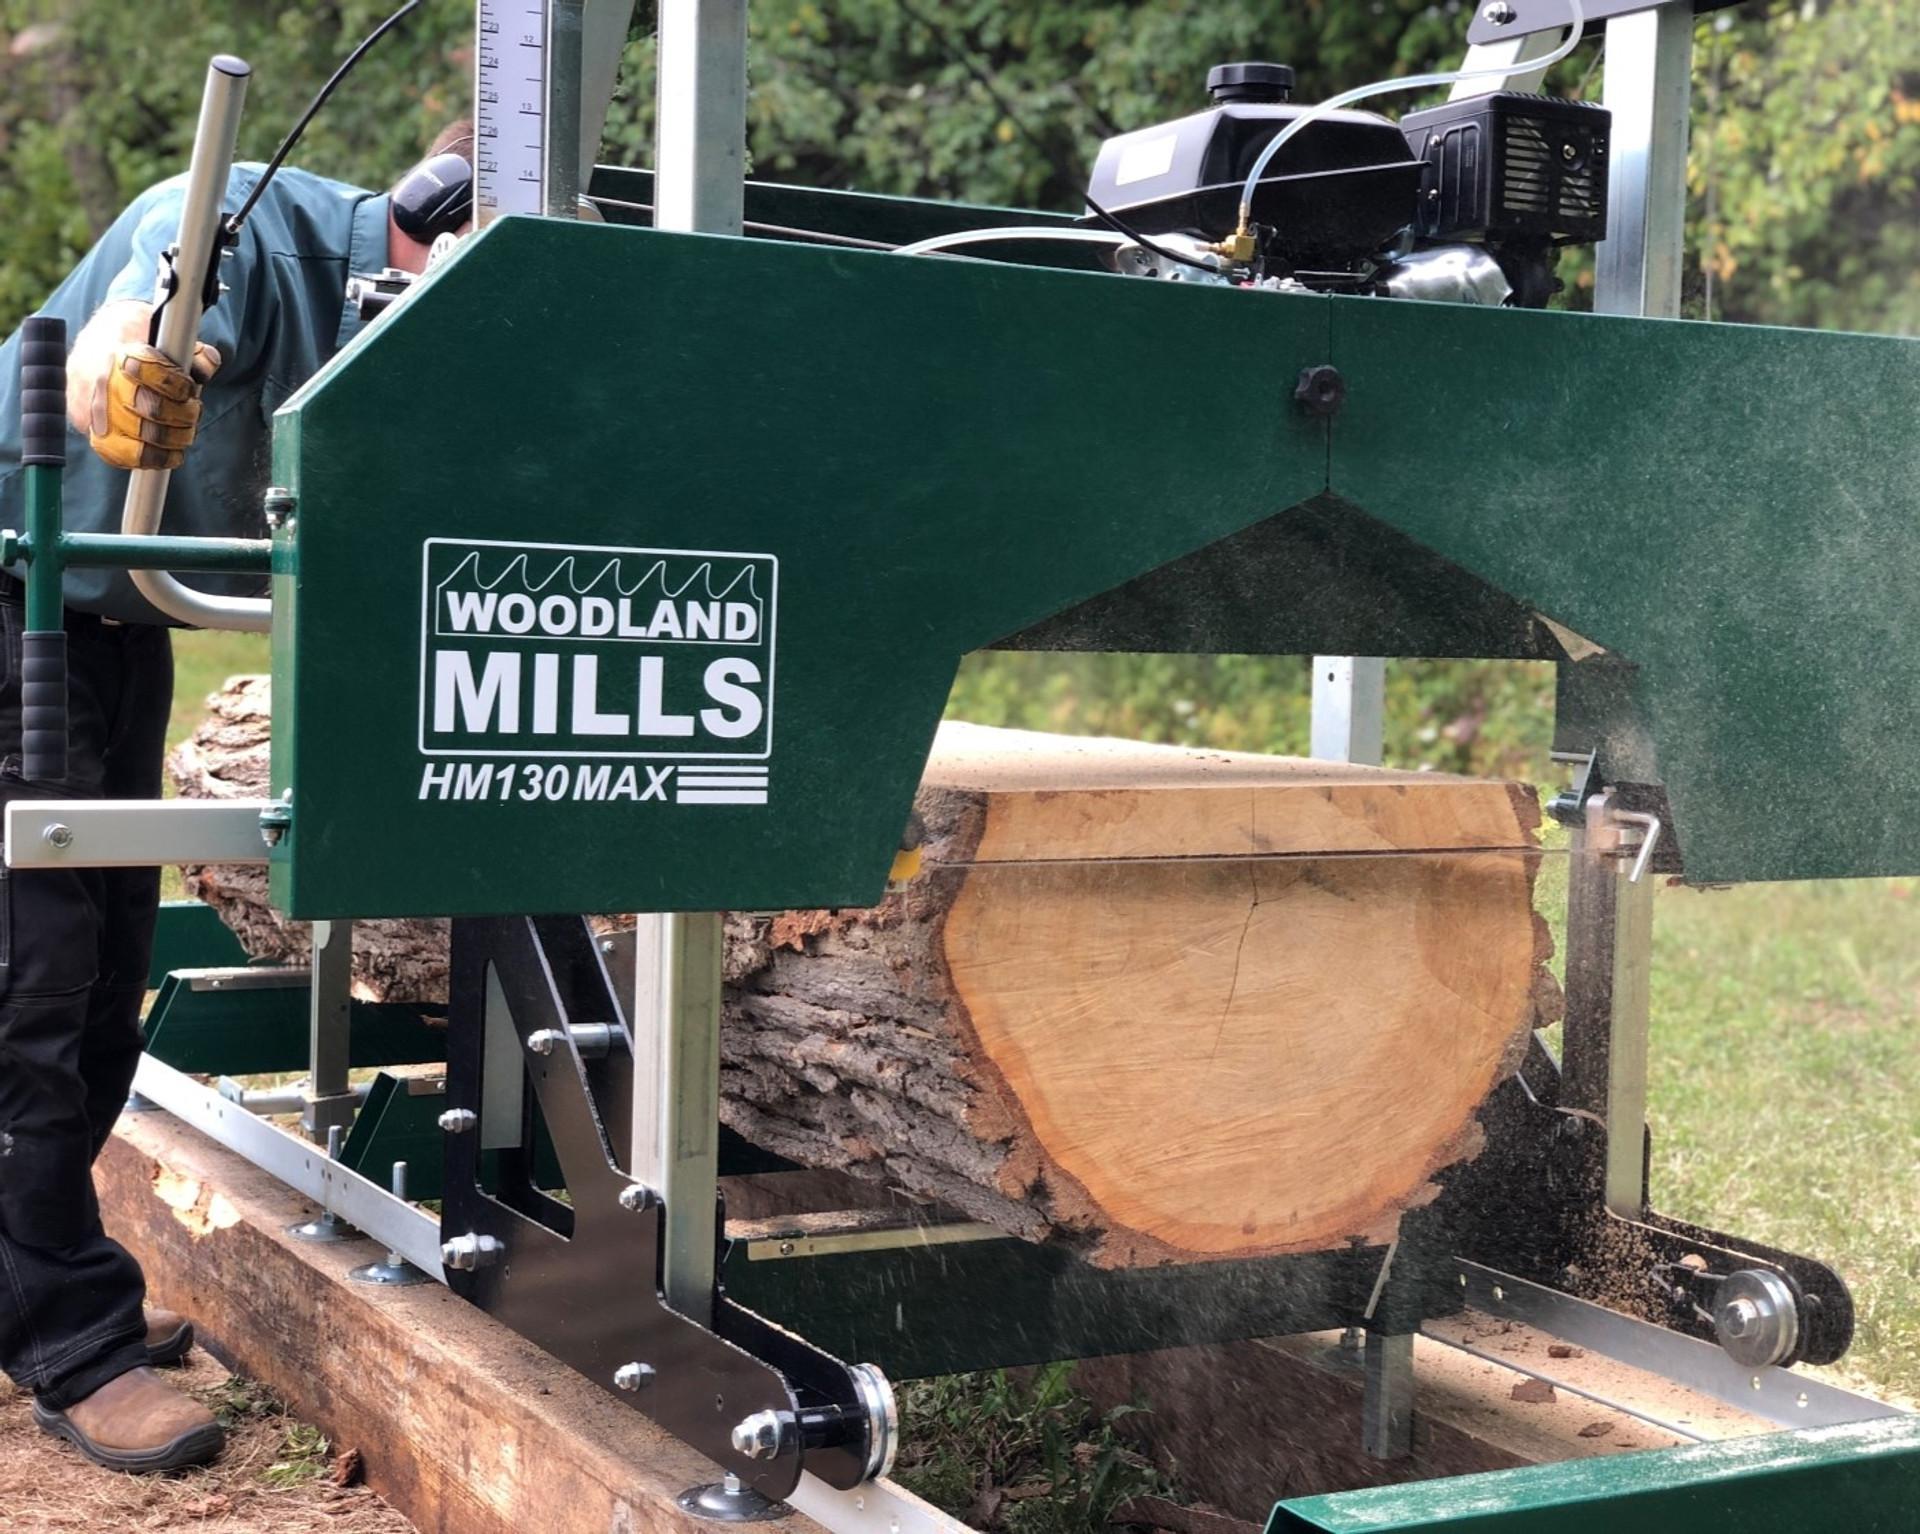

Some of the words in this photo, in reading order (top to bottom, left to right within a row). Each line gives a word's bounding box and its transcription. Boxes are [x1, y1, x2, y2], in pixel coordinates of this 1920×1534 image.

[488, 22, 500, 32] 23
[523, 35, 535, 43] 12
[488, 57, 500, 65] 24
[487, 92, 499, 101] 25
[521, 102, 533, 111] 13
[487, 126, 498, 135] 26
[487, 161, 499, 170] 27
[523, 169, 534, 177] 14
[446, 590, 758, 641] WOODLAND
[433, 649, 763, 738] MILLS
[418, 763, 675, 801] HM130MAX
